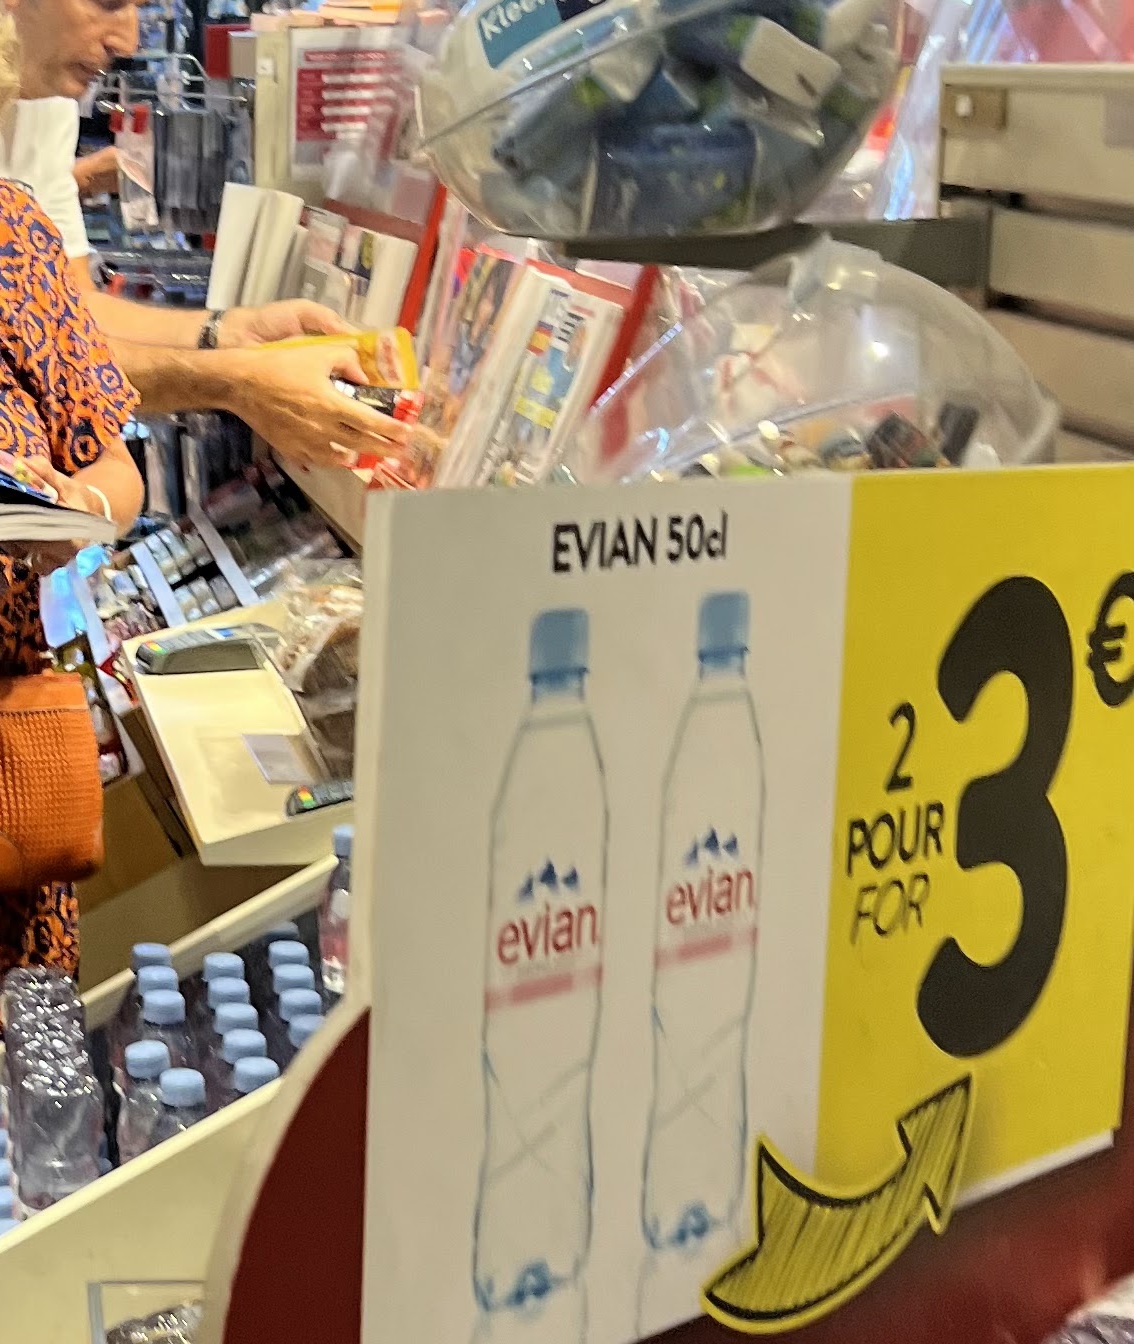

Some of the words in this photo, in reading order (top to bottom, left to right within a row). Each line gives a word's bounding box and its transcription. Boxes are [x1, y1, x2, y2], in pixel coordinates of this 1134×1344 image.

[552, 516, 658, 573] EVIAN
[666, 508, 729, 563] 50cl
[885, 700, 918, 794] 2
[846, 800, 945, 878] POUR
[666, 865, 755, 926] evian
[850, 872, 930, 946] FOR
[496, 902, 598, 966] evian
